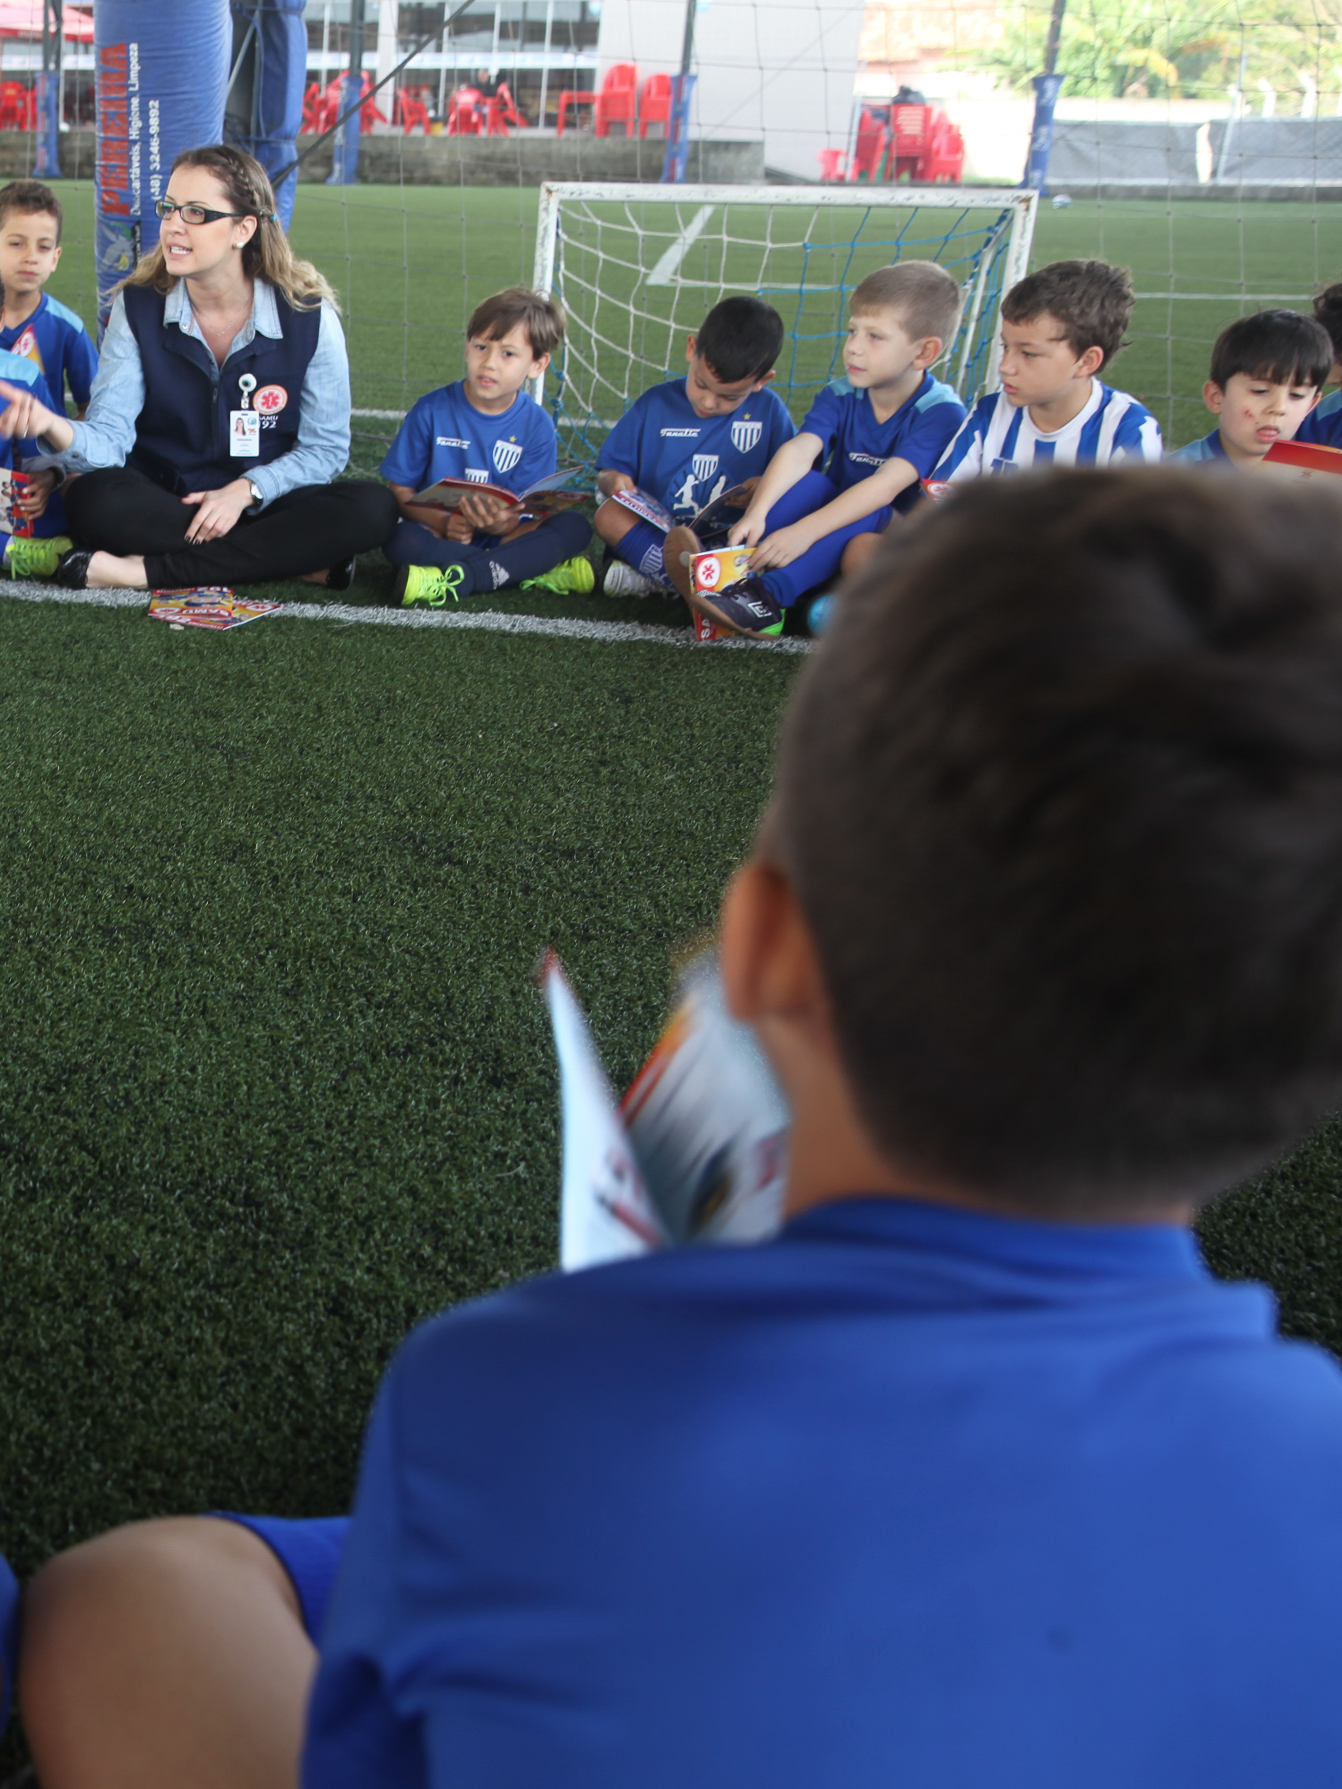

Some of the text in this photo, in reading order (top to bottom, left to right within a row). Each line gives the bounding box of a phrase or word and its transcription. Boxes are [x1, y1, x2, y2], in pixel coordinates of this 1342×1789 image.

[128, 42, 140, 91] Limpeza
[99, 42, 130, 216] PEREIRA
[149, 99, 163, 201] (48) 3246-9892
